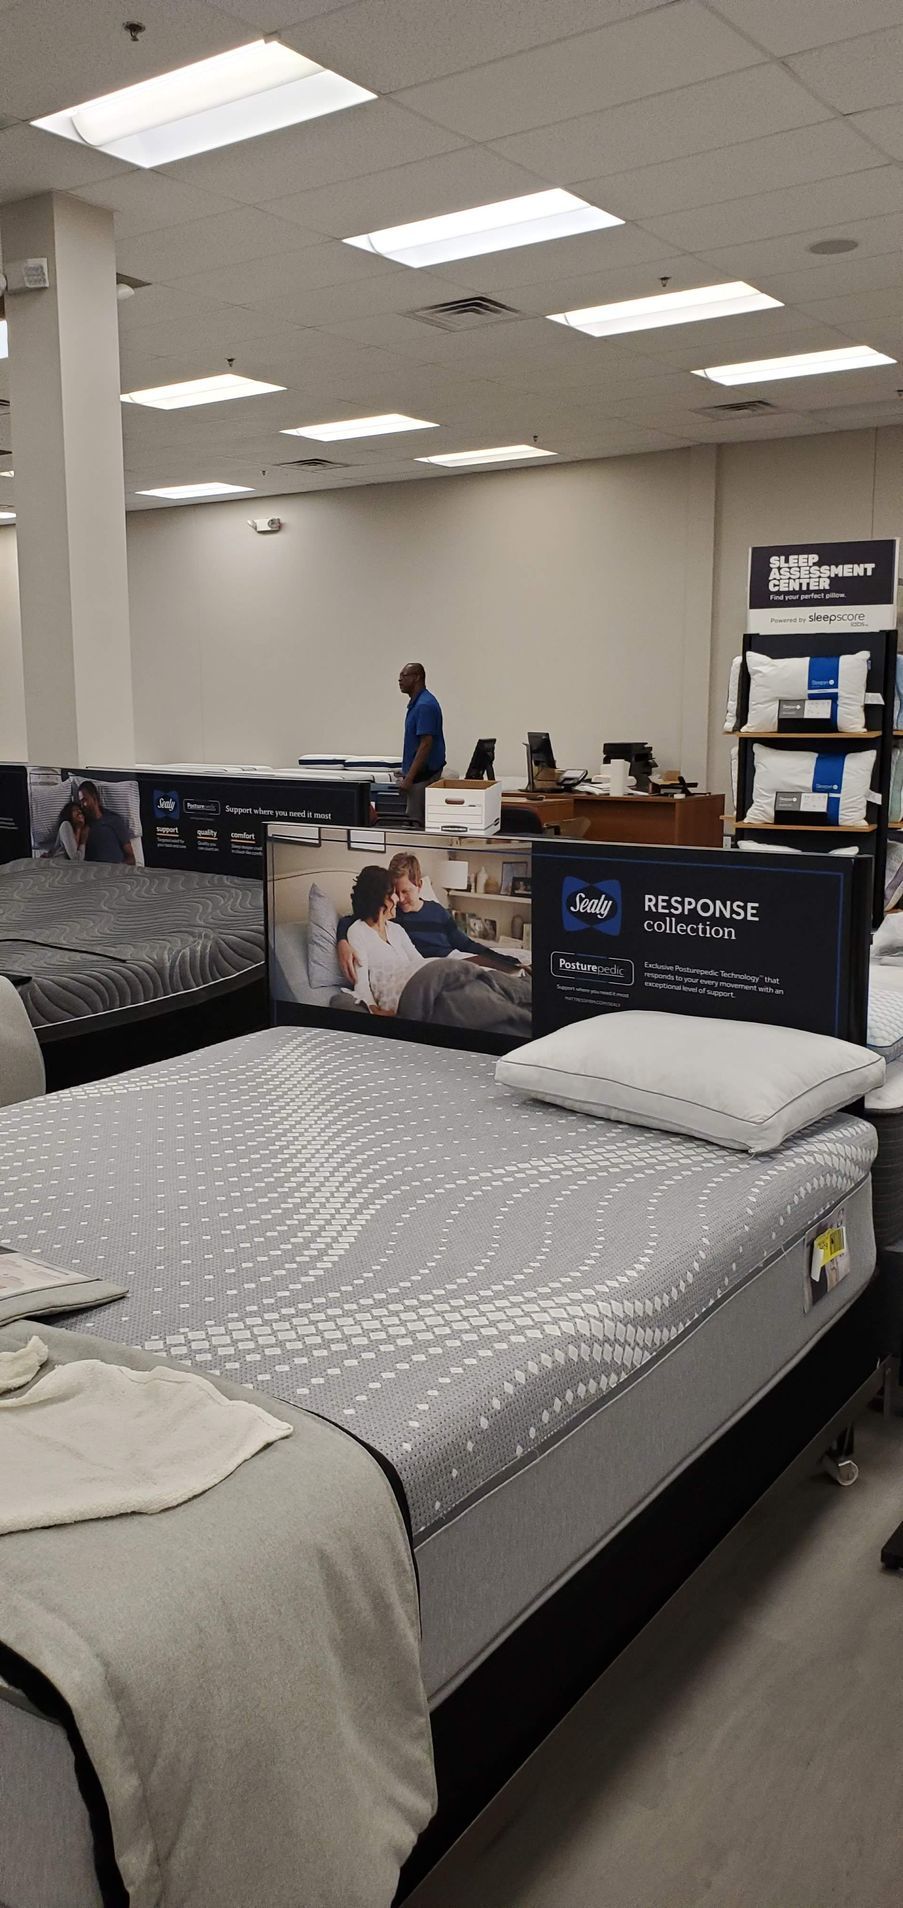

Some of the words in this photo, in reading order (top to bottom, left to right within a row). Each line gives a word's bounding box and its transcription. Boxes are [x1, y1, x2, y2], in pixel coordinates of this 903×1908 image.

[769, 554, 819, 568] SLEEP
[768, 563, 875, 580] ASSESSMENT
[768, 578, 830, 592] CENTER
[800, 593, 824, 601] perfect
[825, 592, 847, 600] pillow.
[808, 612, 865, 625] sleepscore
[157, 798, 176, 811] Sealy
[225, 805, 252, 815] Support
[253, 807, 274, 816] where
[275, 810, 288, 818] you
[289, 810, 306, 818] need
[314, 812, 332, 820] most
[156, 826, 179, 834] support
[196, 828, 218, 838] quality
[230, 832, 256, 840] comfort
[570, 892, 613, 919] Sealy
[644, 895, 760, 921] RESPONSE
[643, 917, 736, 940] collection
[559, 958, 625, 976] Posturepedic
[644, 961, 674, 972] Exclusive
[674, 964, 719, 977] Posturepedic
[764, 976, 780, 985] that
[556, 983, 576, 992] Support
[644, 972, 675, 981] responds
[684, 977, 699, 985] your
[699, 979, 719, 988] every
[719, 981, 757, 992] movement
[758, 985, 774, 994] with
[644, 981, 682, 991] exceptional
[682, 985, 698, 993] level
[706, 988, 736, 999] support.
